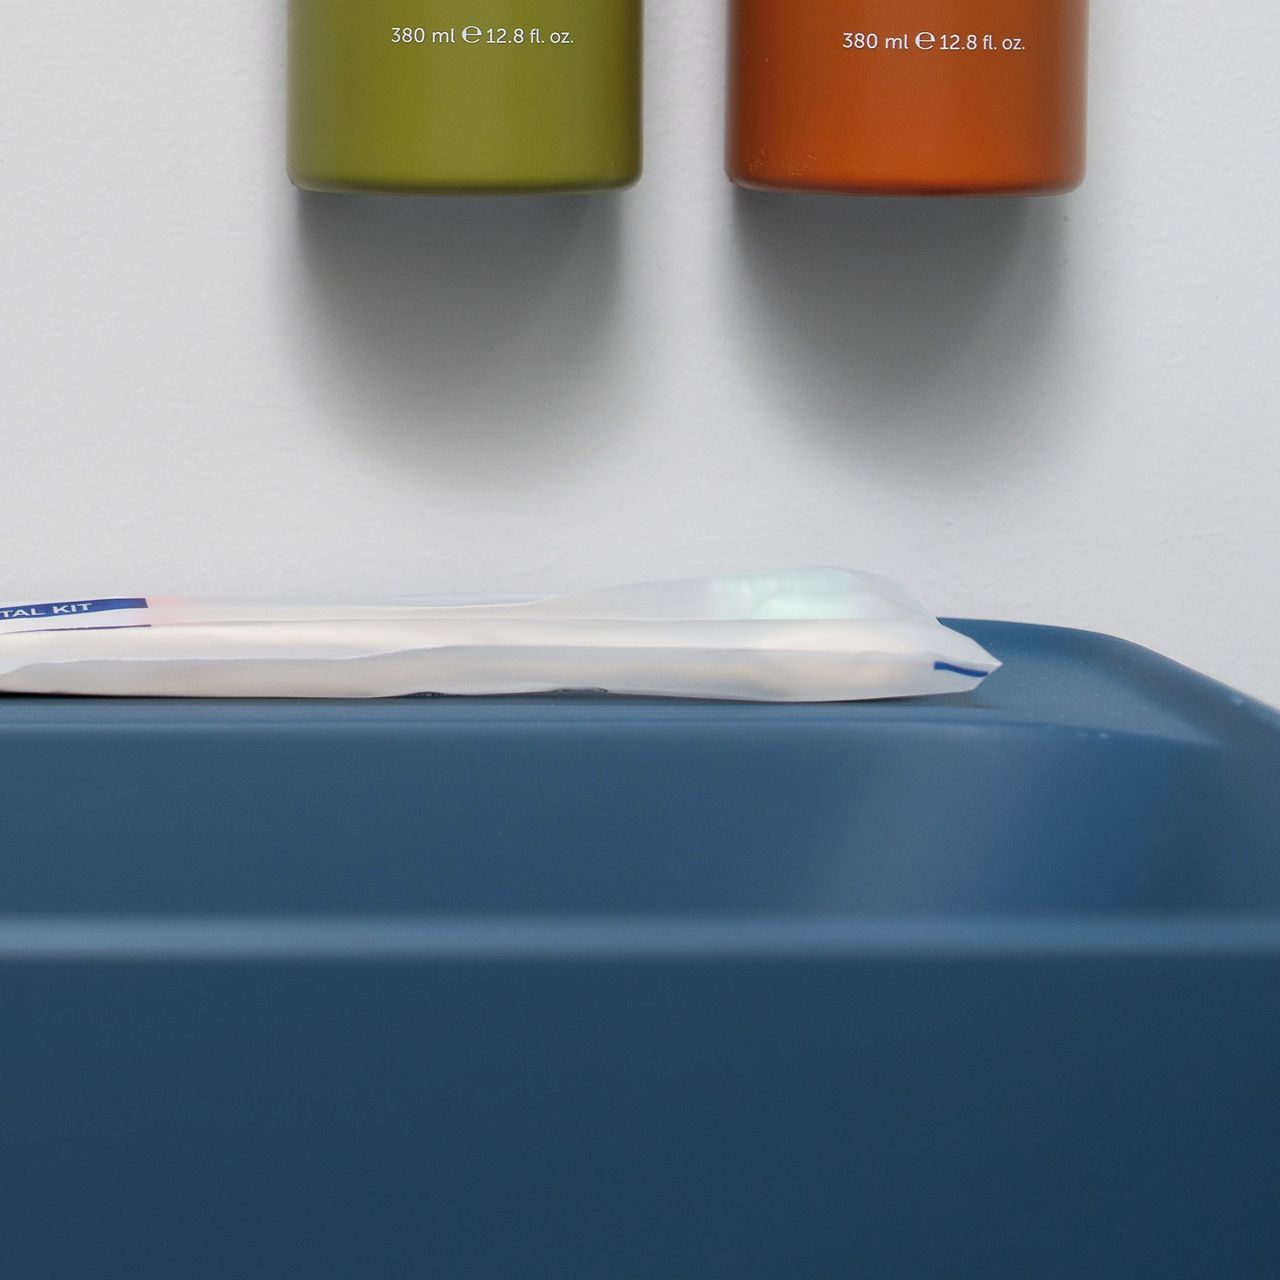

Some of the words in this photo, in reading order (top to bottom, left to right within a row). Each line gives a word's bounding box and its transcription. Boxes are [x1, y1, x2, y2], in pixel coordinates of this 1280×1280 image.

[391, 27, 426, 43] 380
[432, 27, 456, 43] ml
[486, 28, 525, 44] 12.8
[529, 28, 545, 44] fl.
[549, 31, 574, 44] oz.
[842, 32, 879, 49] 380
[884, 33, 909, 50] ml
[939, 34, 978, 51] 12.8
[982, 34, 998, 51] fl.
[1001, 37, 1026, 51] oz.
[53, 603, 93, 615] KIT
